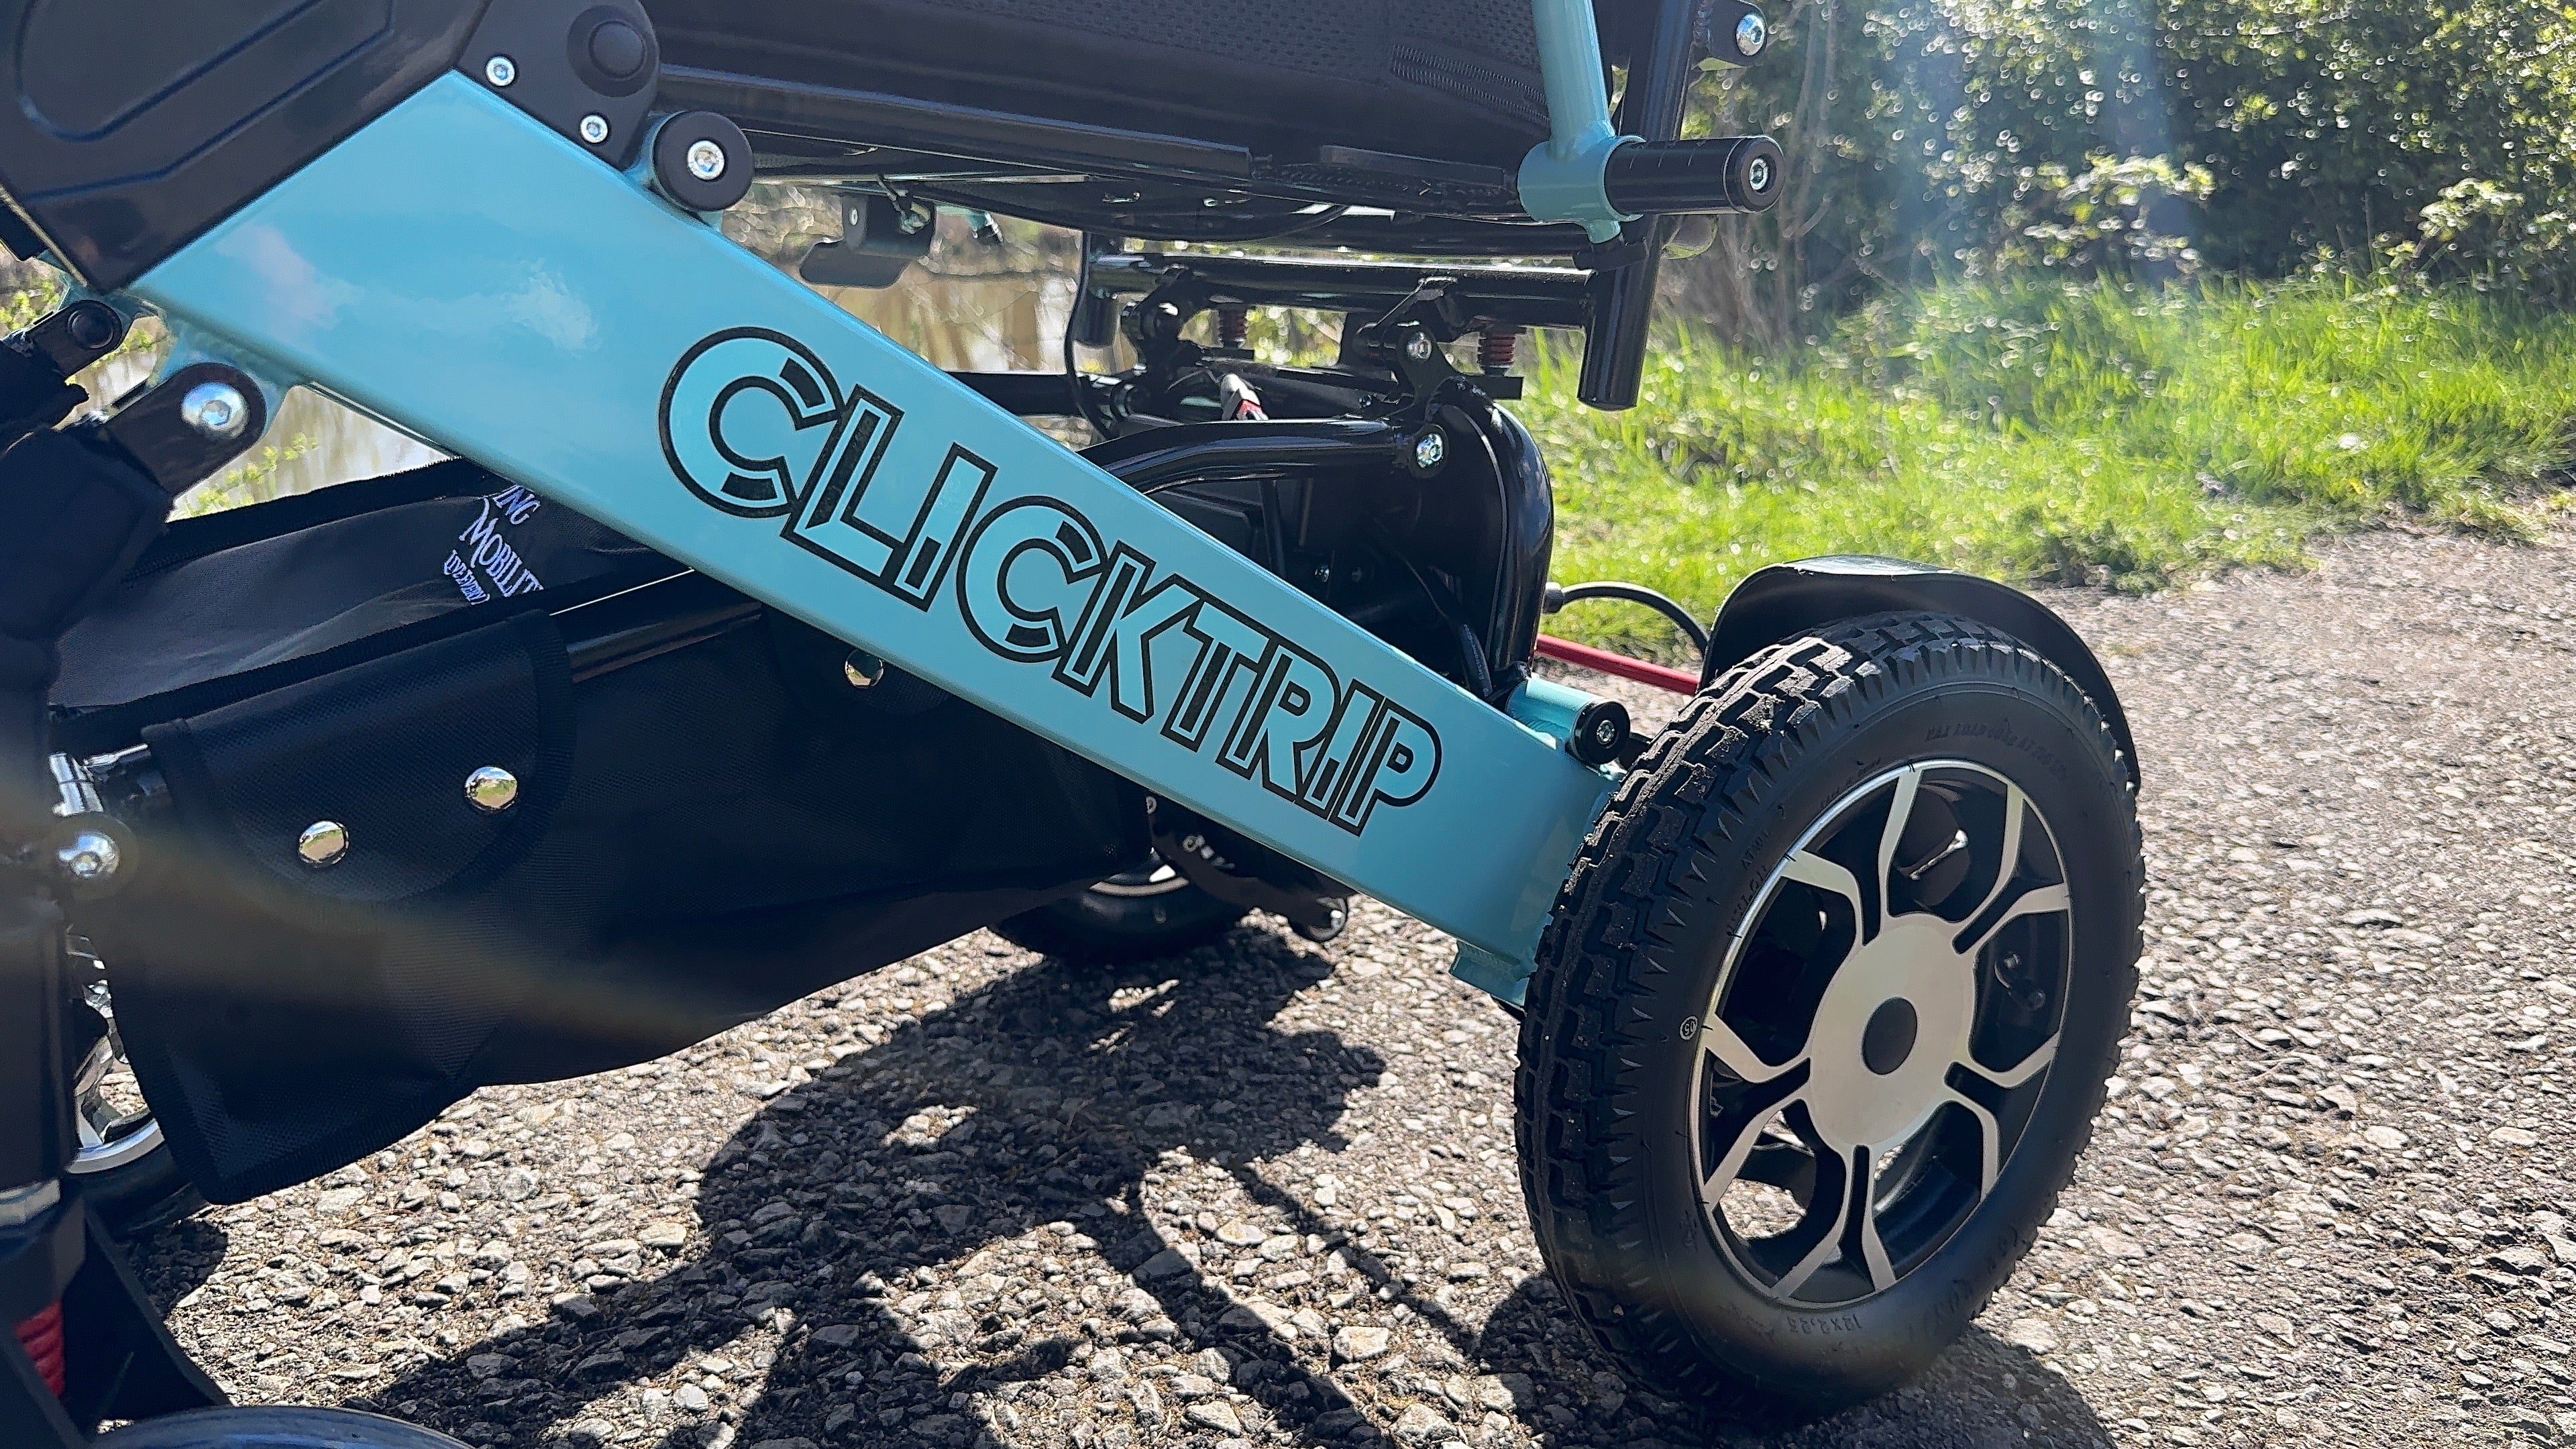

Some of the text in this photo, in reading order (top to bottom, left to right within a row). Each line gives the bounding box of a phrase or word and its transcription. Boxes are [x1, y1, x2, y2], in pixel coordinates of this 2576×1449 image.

[458, 497, 544, 597] MOBILIT
[492, 484, 541, 525] ING
[658, 326, 1442, 837] CLICKTRIP
